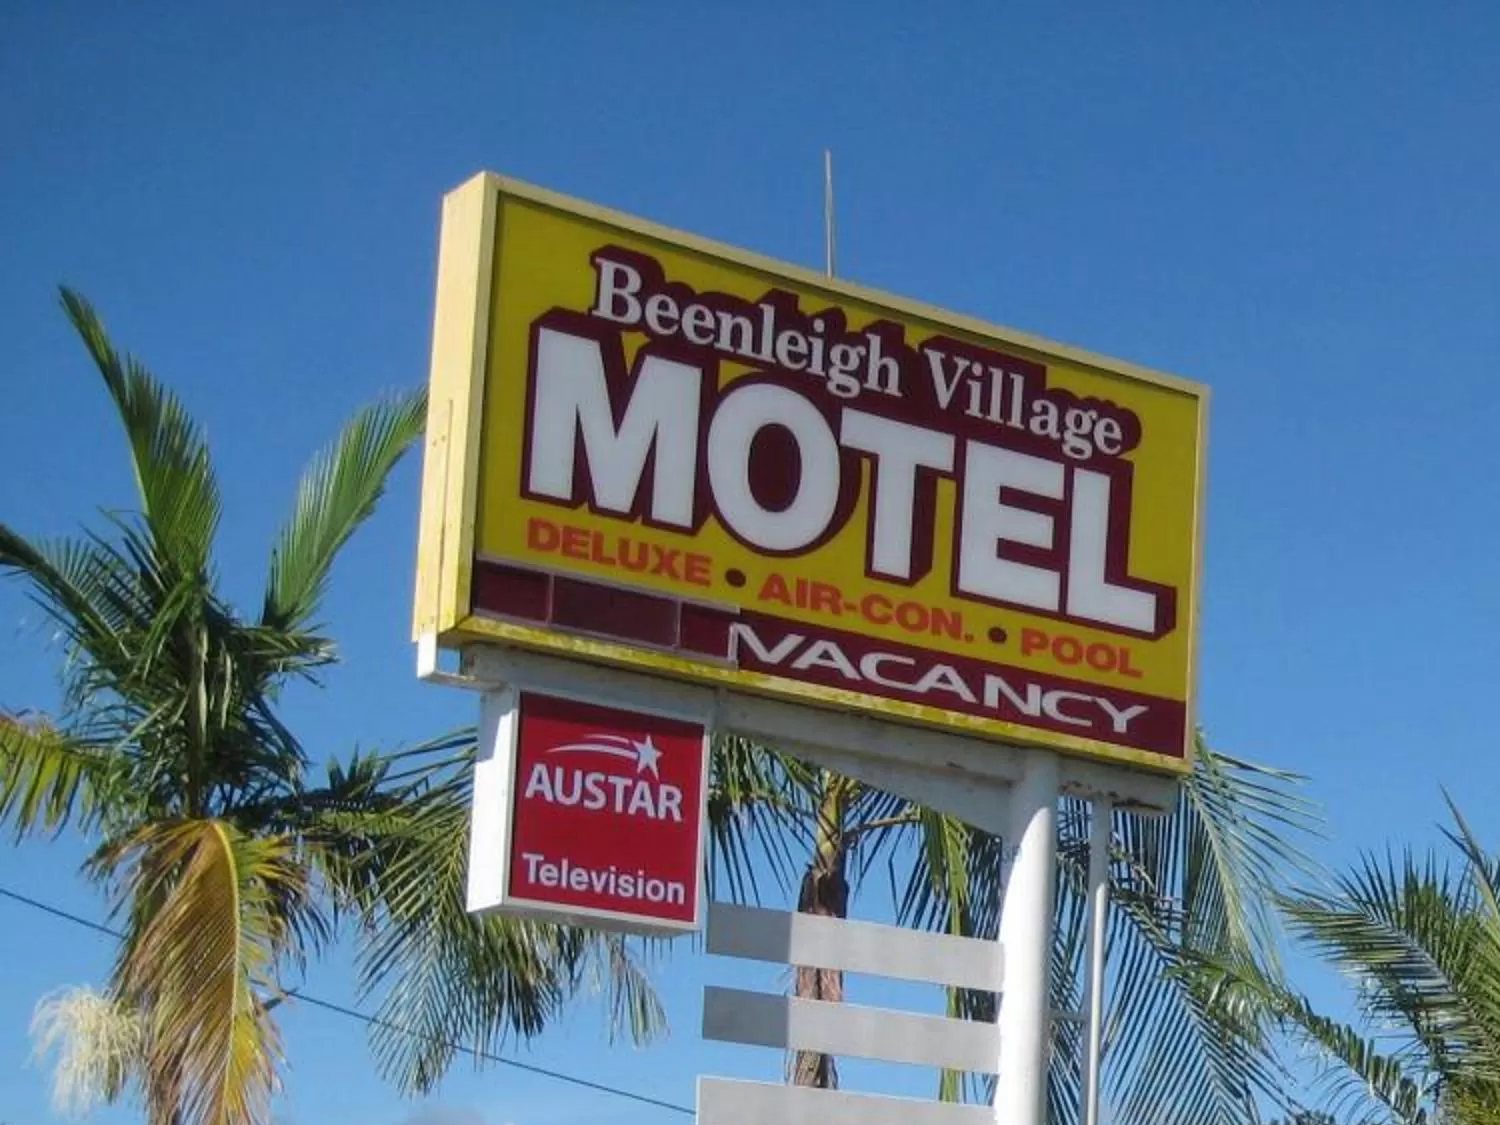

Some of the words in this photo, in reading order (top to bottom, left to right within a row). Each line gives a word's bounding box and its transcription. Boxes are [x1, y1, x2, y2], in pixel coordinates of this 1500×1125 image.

[591, 257, 903, 399] Beenleigh
[924, 347, 1123, 460] Village
[528, 326, 1157, 634] MOTEL
[527, 517, 713, 587] DELUXE
[757, 573, 974, 643] AIR-CON.
[1020, 627, 1143, 679] POOL
[730, 621, 1149, 734] VACANCY
[525, 763, 683, 822] AUSTAR
[522, 852, 685, 904] Television
